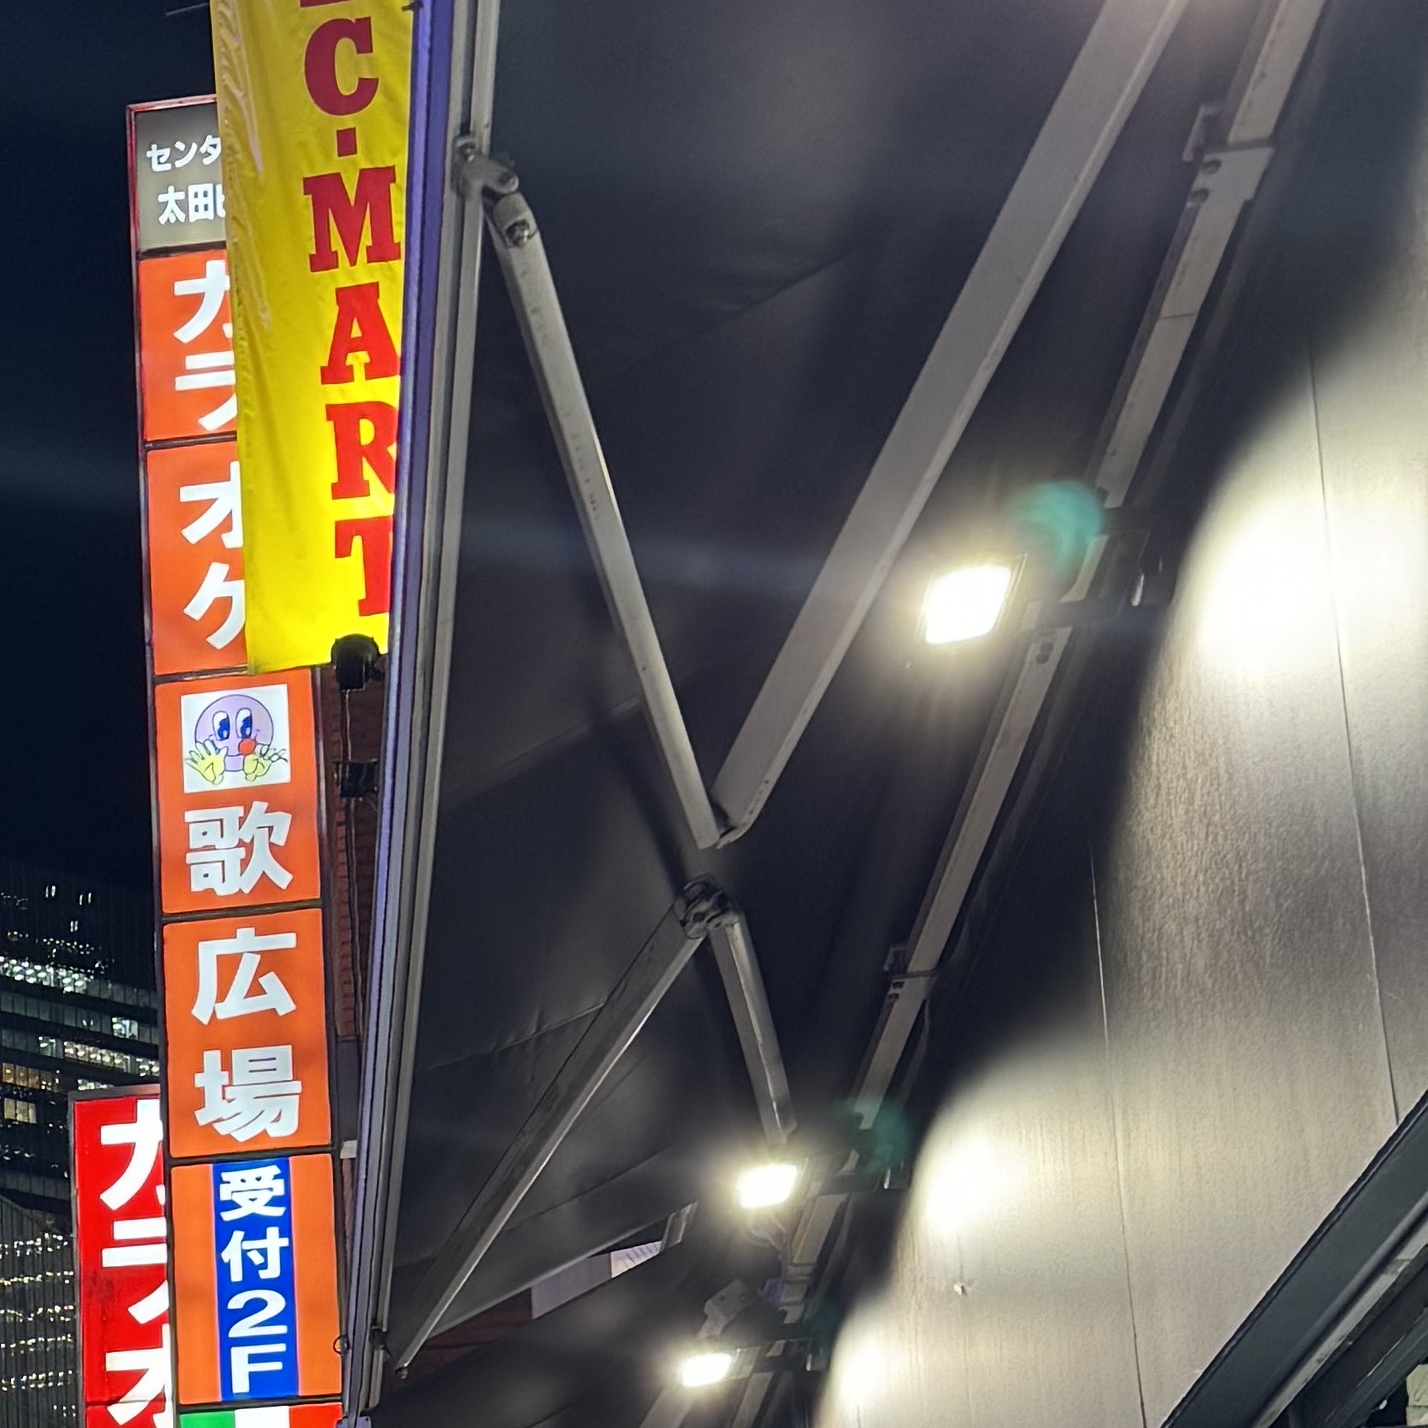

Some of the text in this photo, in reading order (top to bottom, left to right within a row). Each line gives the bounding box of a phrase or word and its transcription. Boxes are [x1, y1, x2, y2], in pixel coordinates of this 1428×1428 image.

[183, 800, 303, 1143] 歌広場
[218, 1165, 290, 1397] 受付2F
